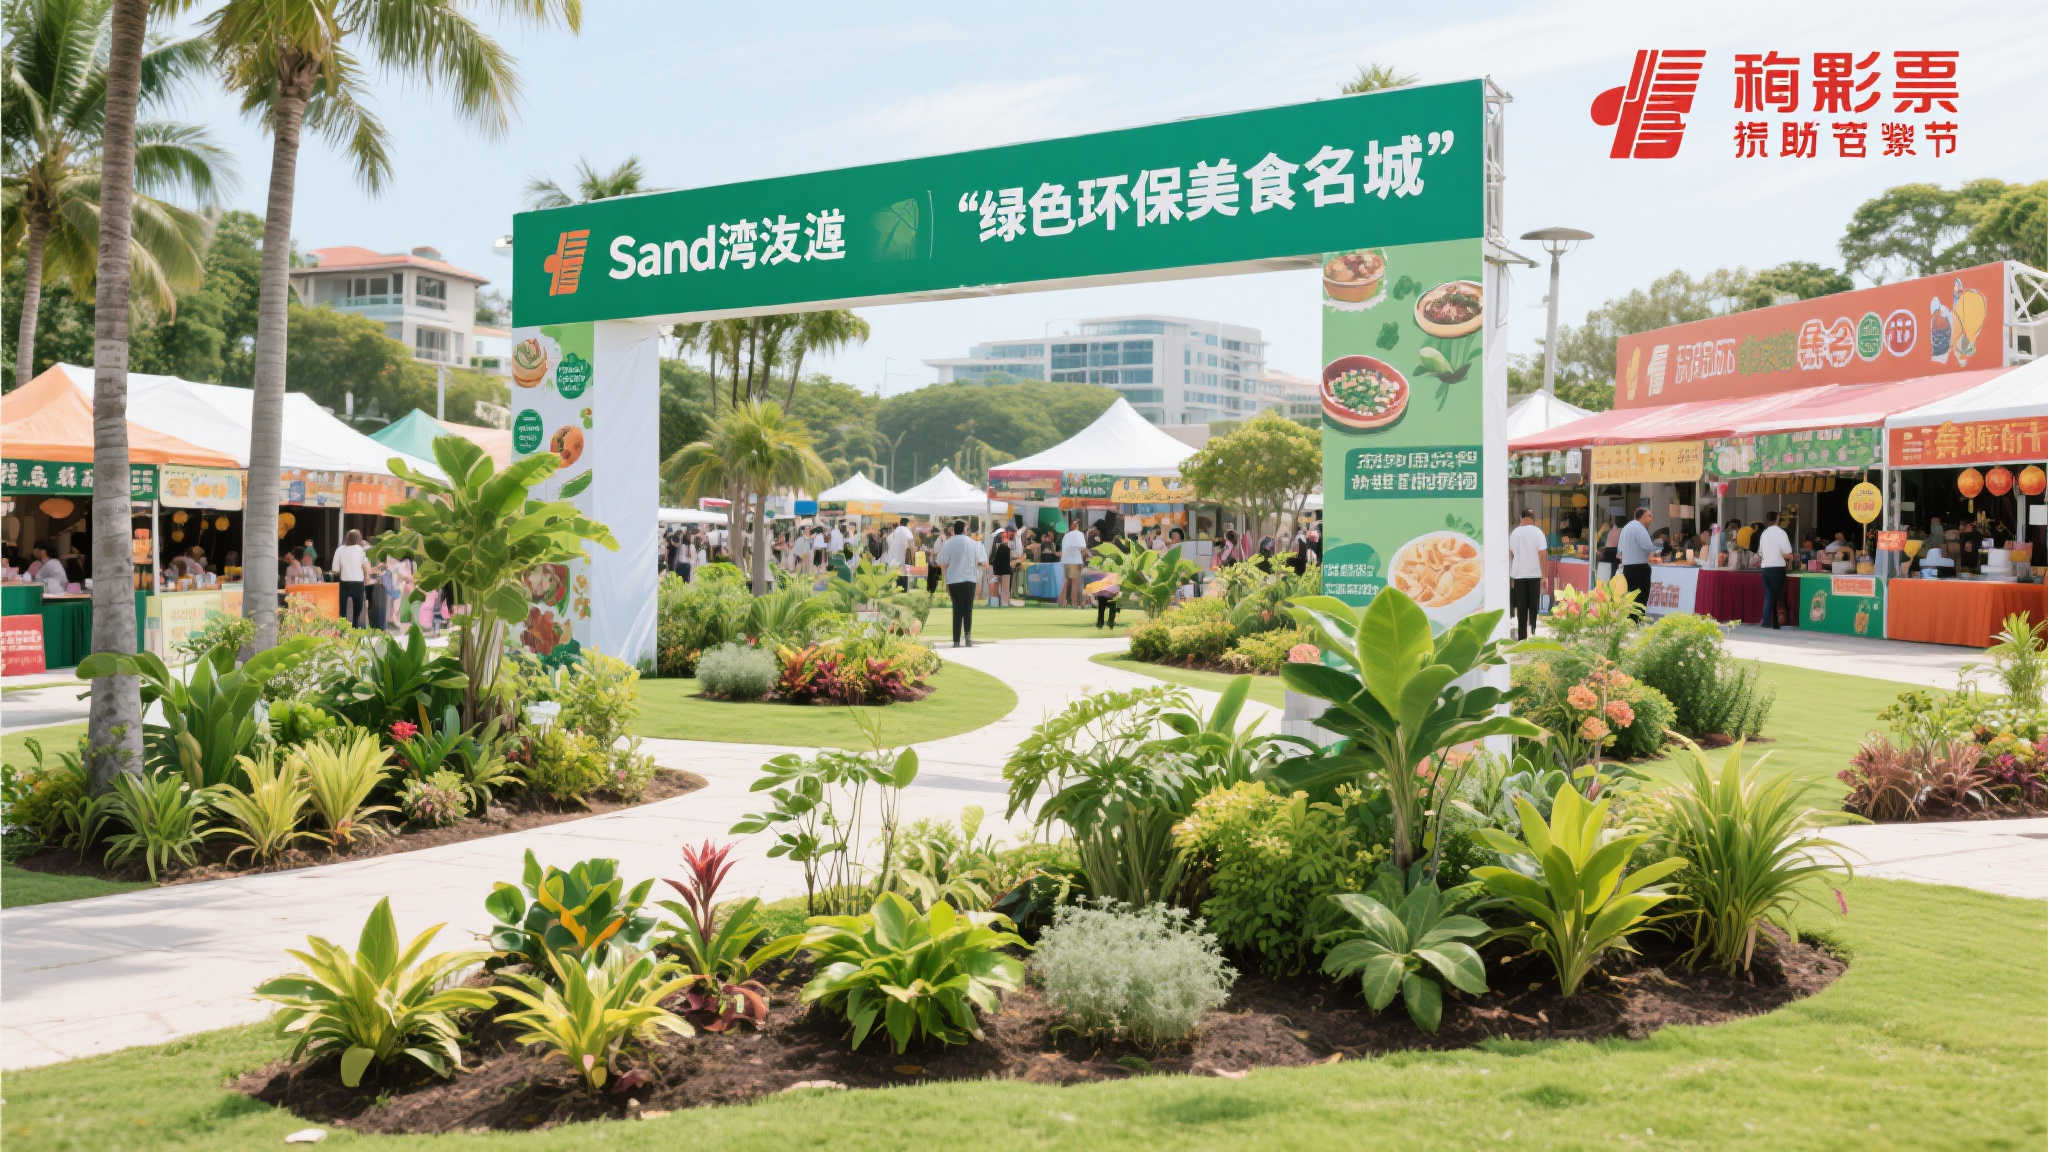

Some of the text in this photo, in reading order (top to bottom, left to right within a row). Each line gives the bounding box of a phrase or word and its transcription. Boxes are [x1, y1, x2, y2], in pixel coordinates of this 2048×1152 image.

[958, 130, 1455, 243] “绿色环保美食名城”
